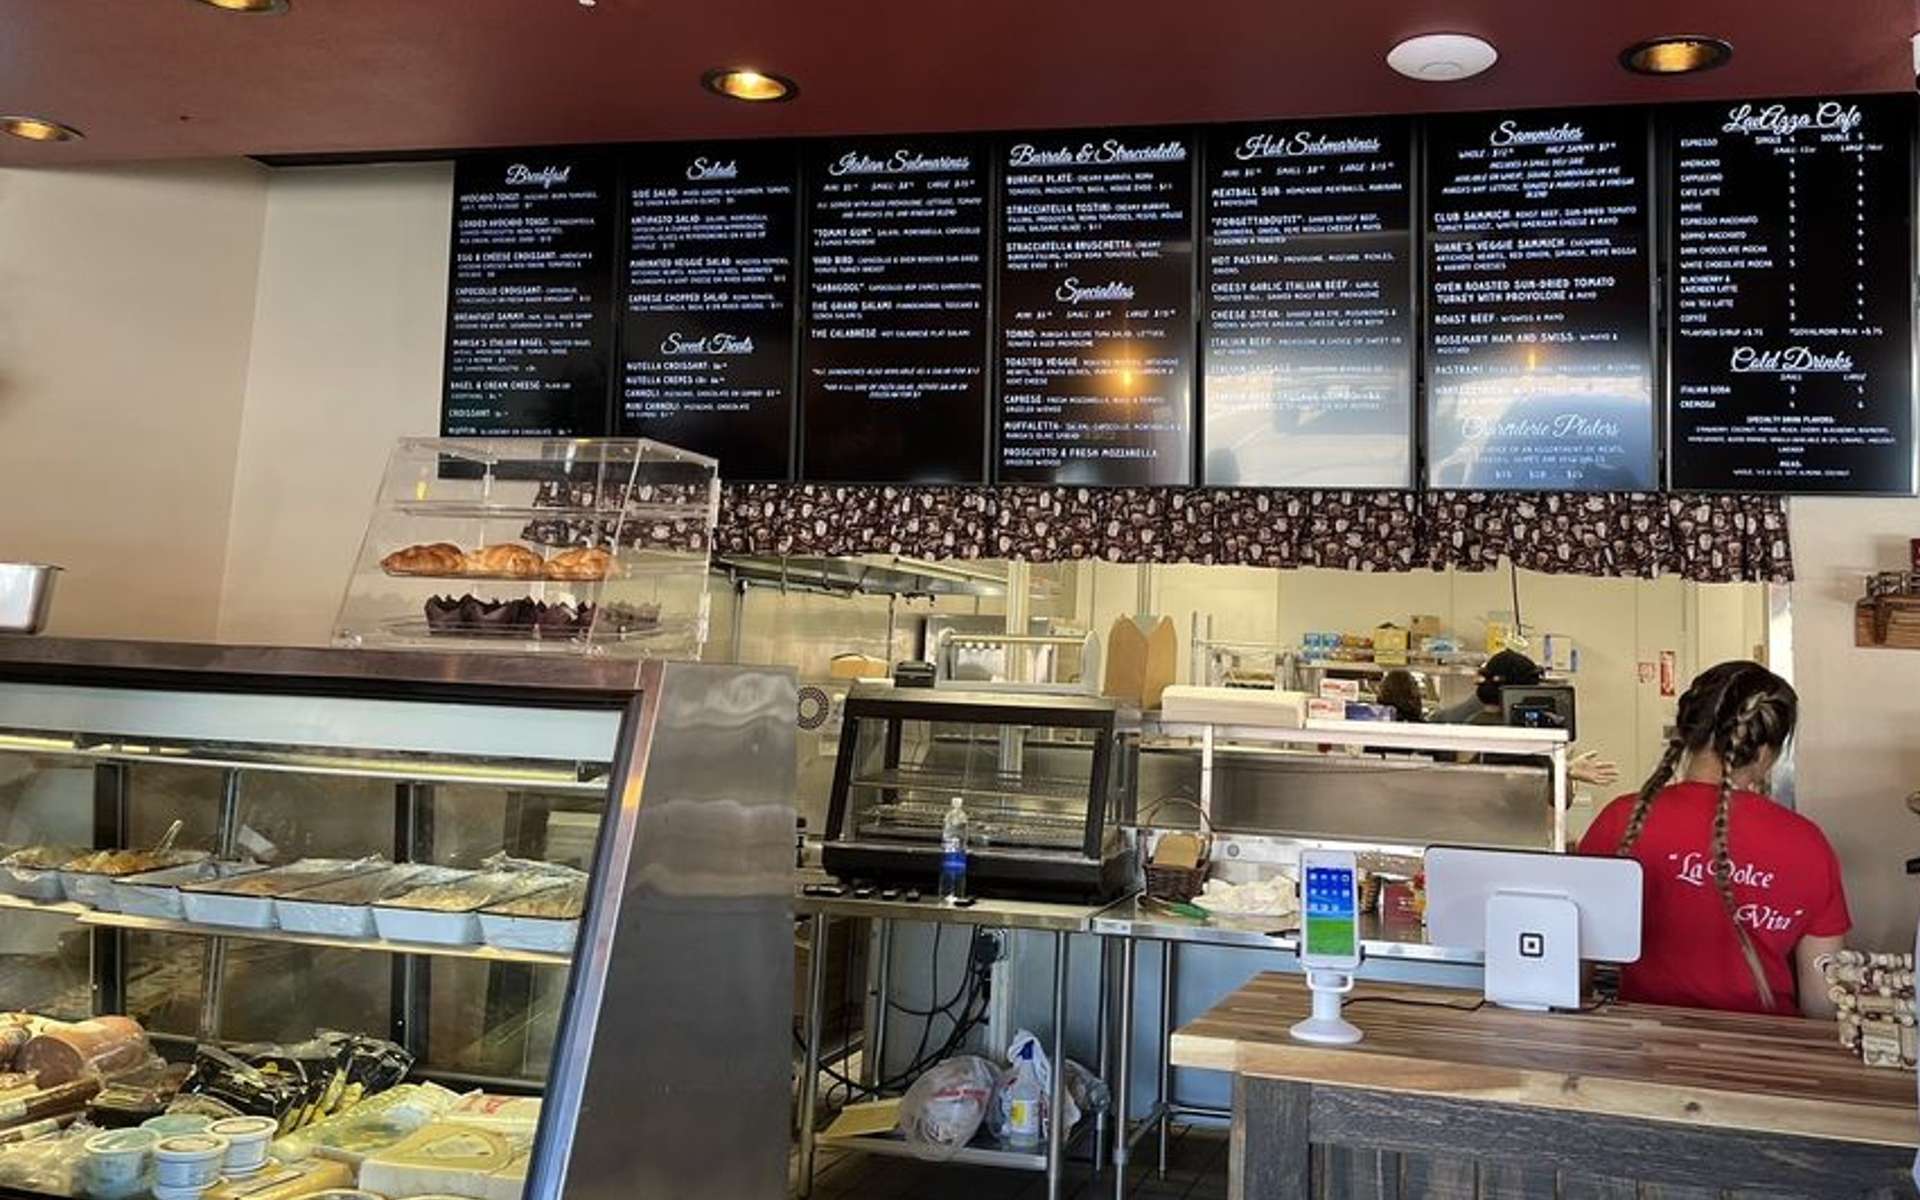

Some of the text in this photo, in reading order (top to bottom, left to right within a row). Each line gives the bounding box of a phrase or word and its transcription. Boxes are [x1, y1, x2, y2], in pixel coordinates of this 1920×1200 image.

[1076, 144, 1093, 163] &
[1731, 347, 1853, 372] Cold Drinks
